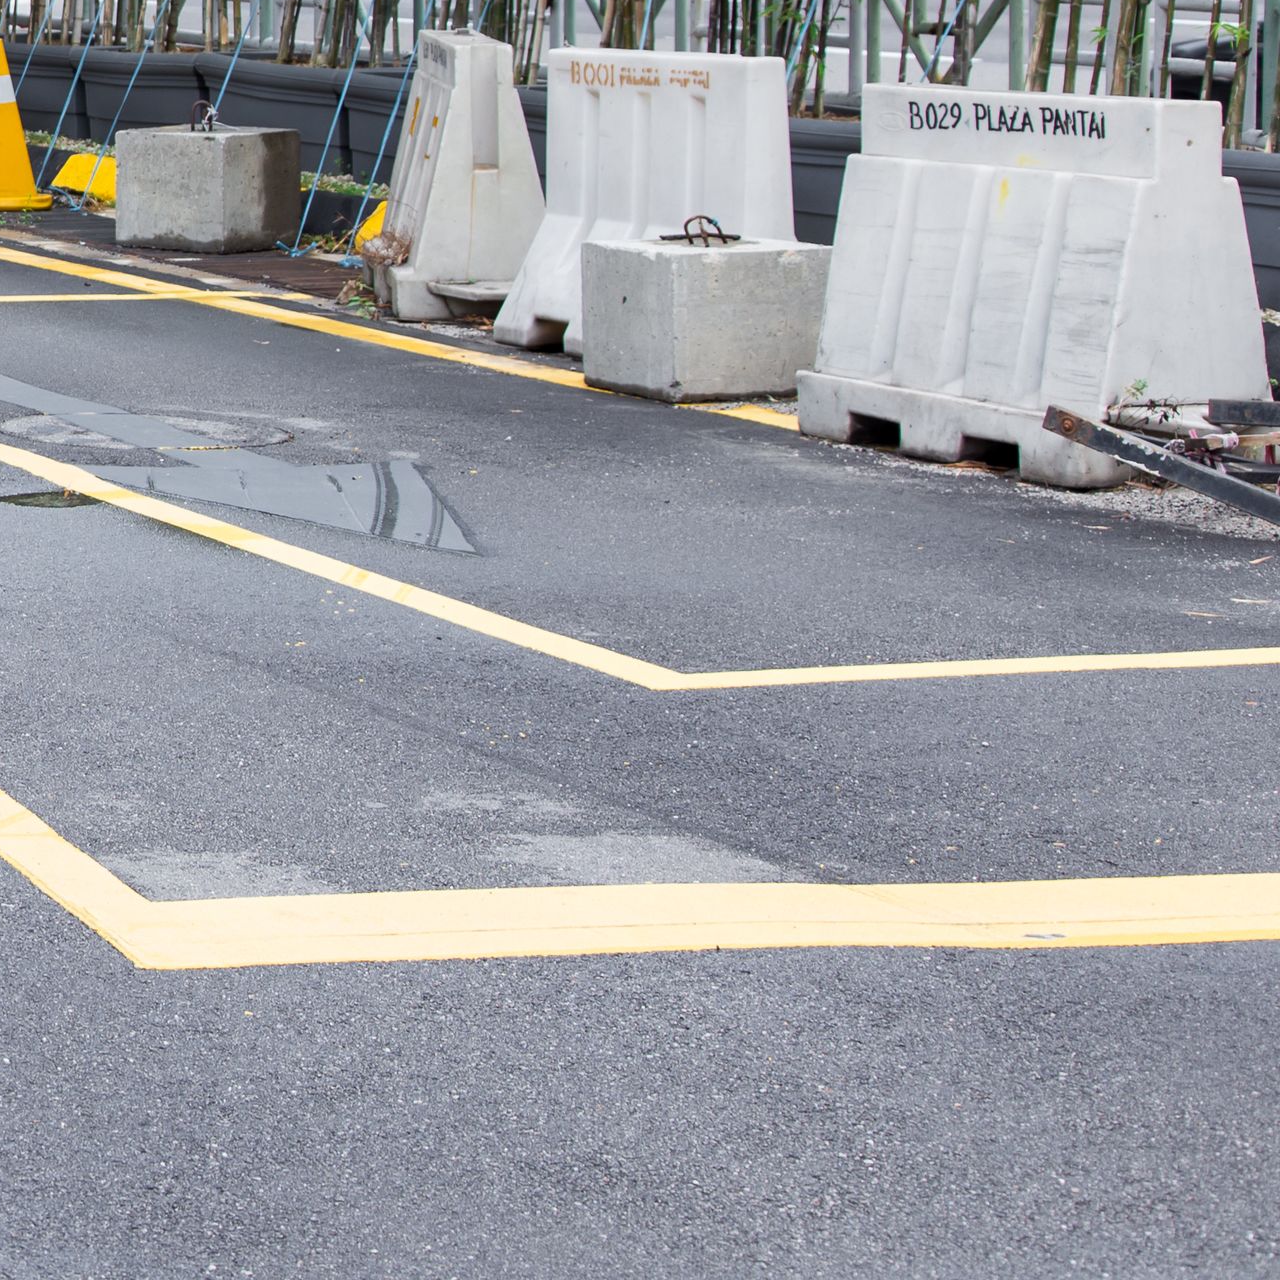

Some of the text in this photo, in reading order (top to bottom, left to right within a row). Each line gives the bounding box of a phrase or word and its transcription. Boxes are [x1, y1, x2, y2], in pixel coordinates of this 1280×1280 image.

[908, 101, 1106, 139] B029 PLAZA PANTAI
